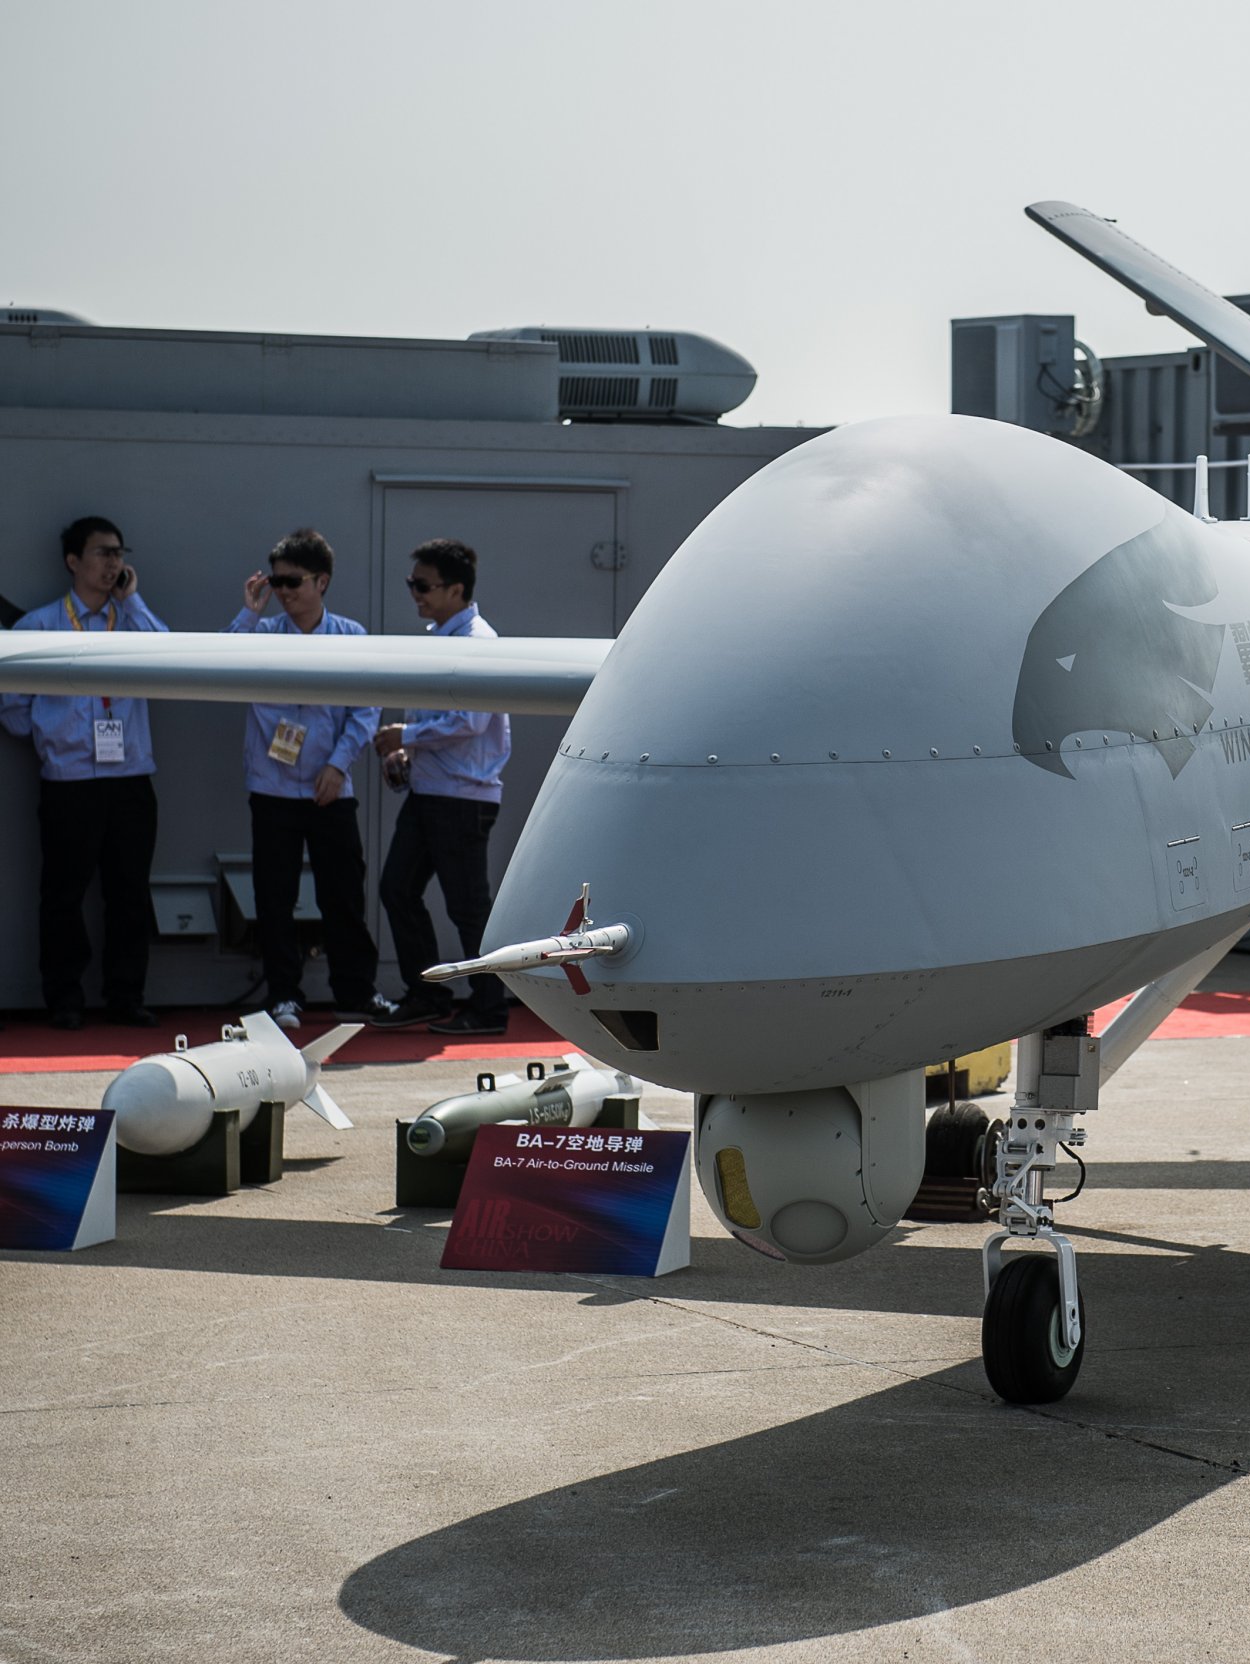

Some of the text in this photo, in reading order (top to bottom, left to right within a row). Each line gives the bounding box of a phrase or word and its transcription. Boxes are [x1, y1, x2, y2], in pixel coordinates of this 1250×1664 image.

[821, 989, 852, 998] 1211-1
[2, 1113, 96, 1132] 杀爆型炸弹
[44, 1140, 79, 1152] Bomb
[516, 1133, 644, 1153] BA-7空地导弹
[493, 1156, 654, 1173] BA-7 Air-to-Ground Missile
